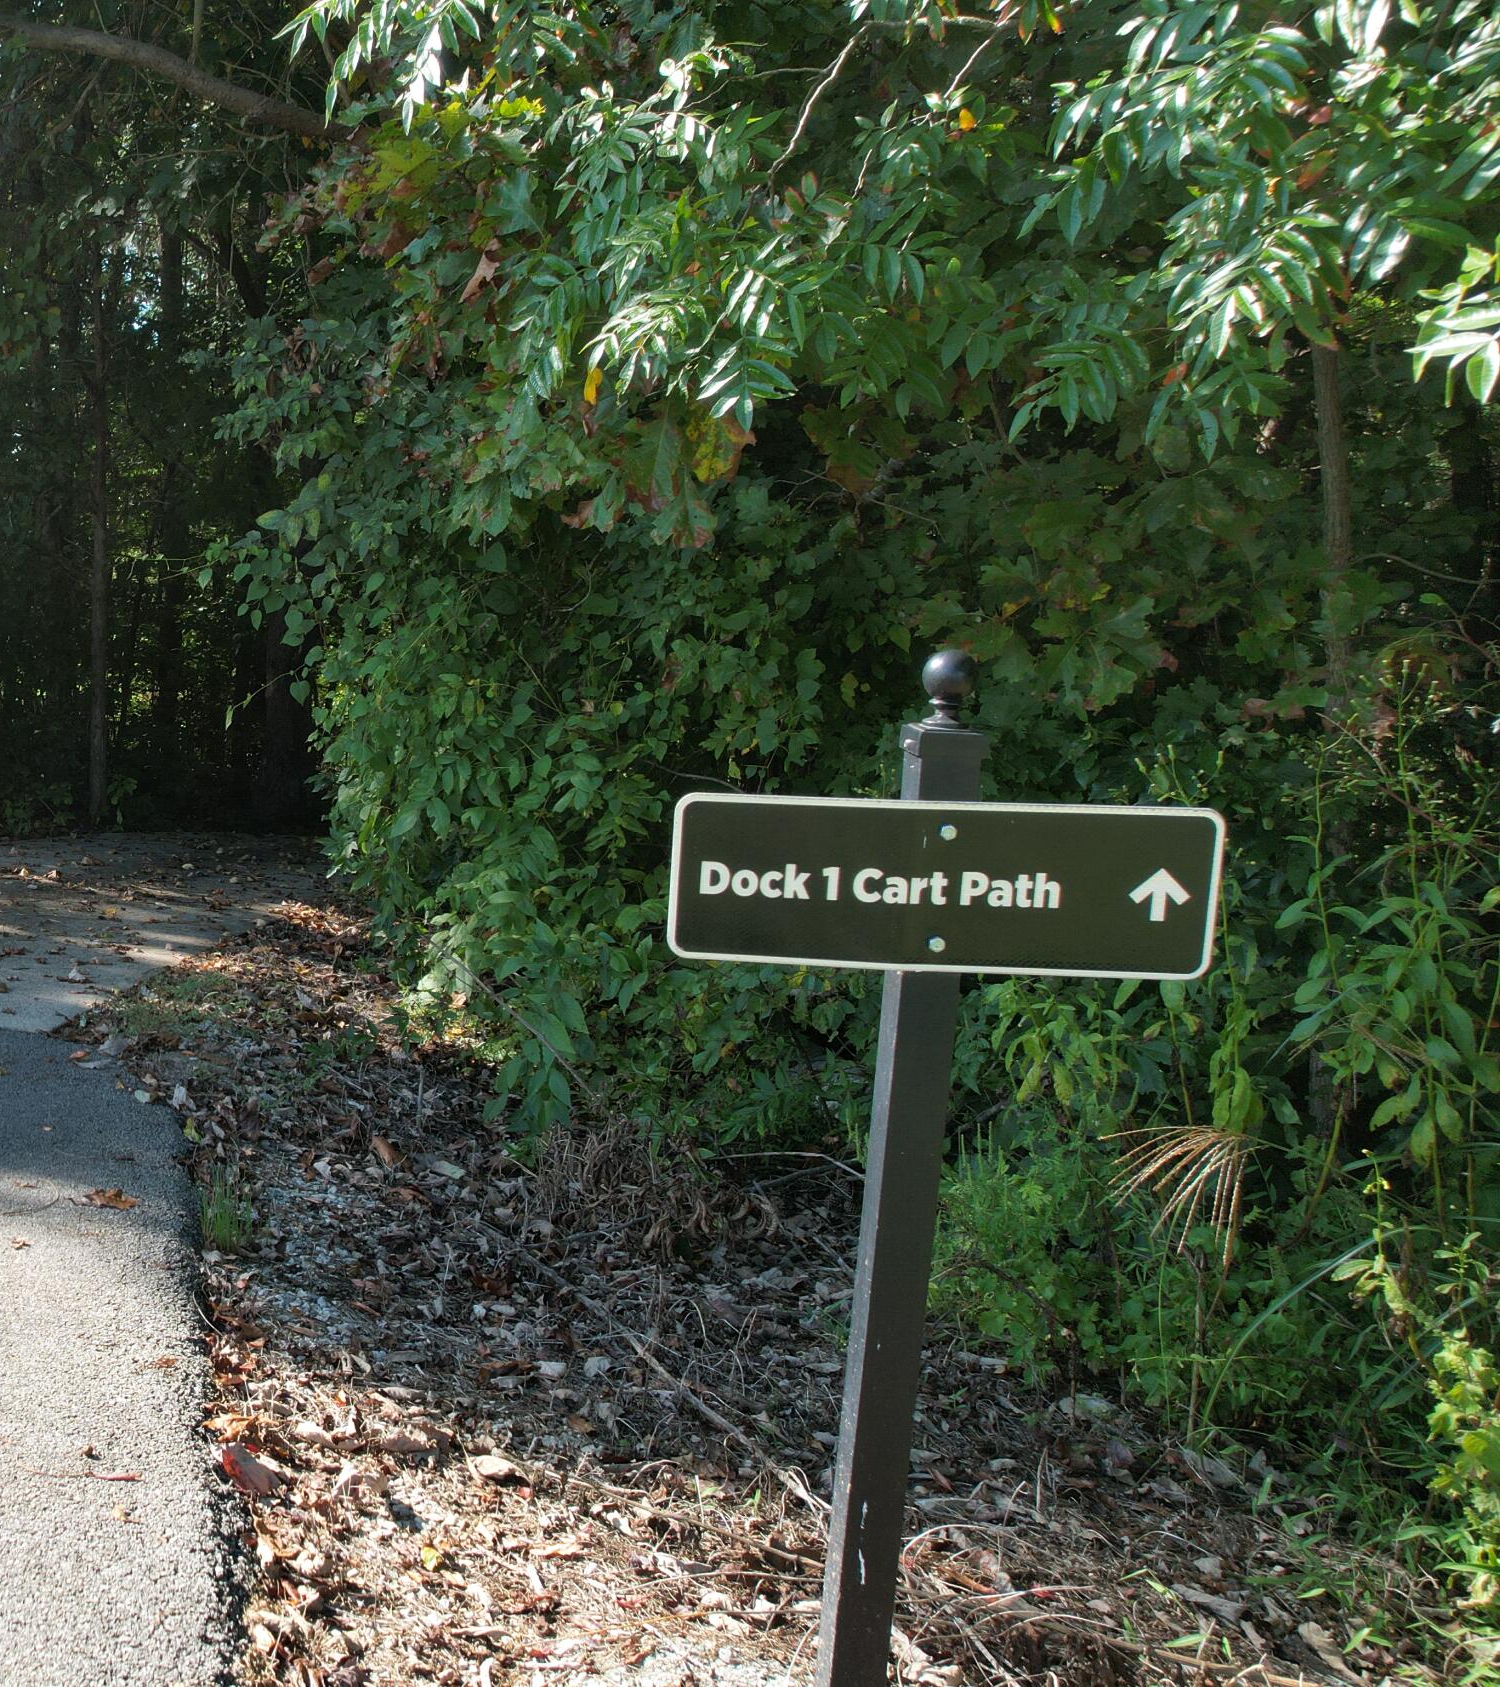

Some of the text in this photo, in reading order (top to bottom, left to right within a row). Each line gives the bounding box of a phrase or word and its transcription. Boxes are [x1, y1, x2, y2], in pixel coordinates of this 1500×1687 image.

[699, 860, 1061, 909] Dock 1 Cart Path
